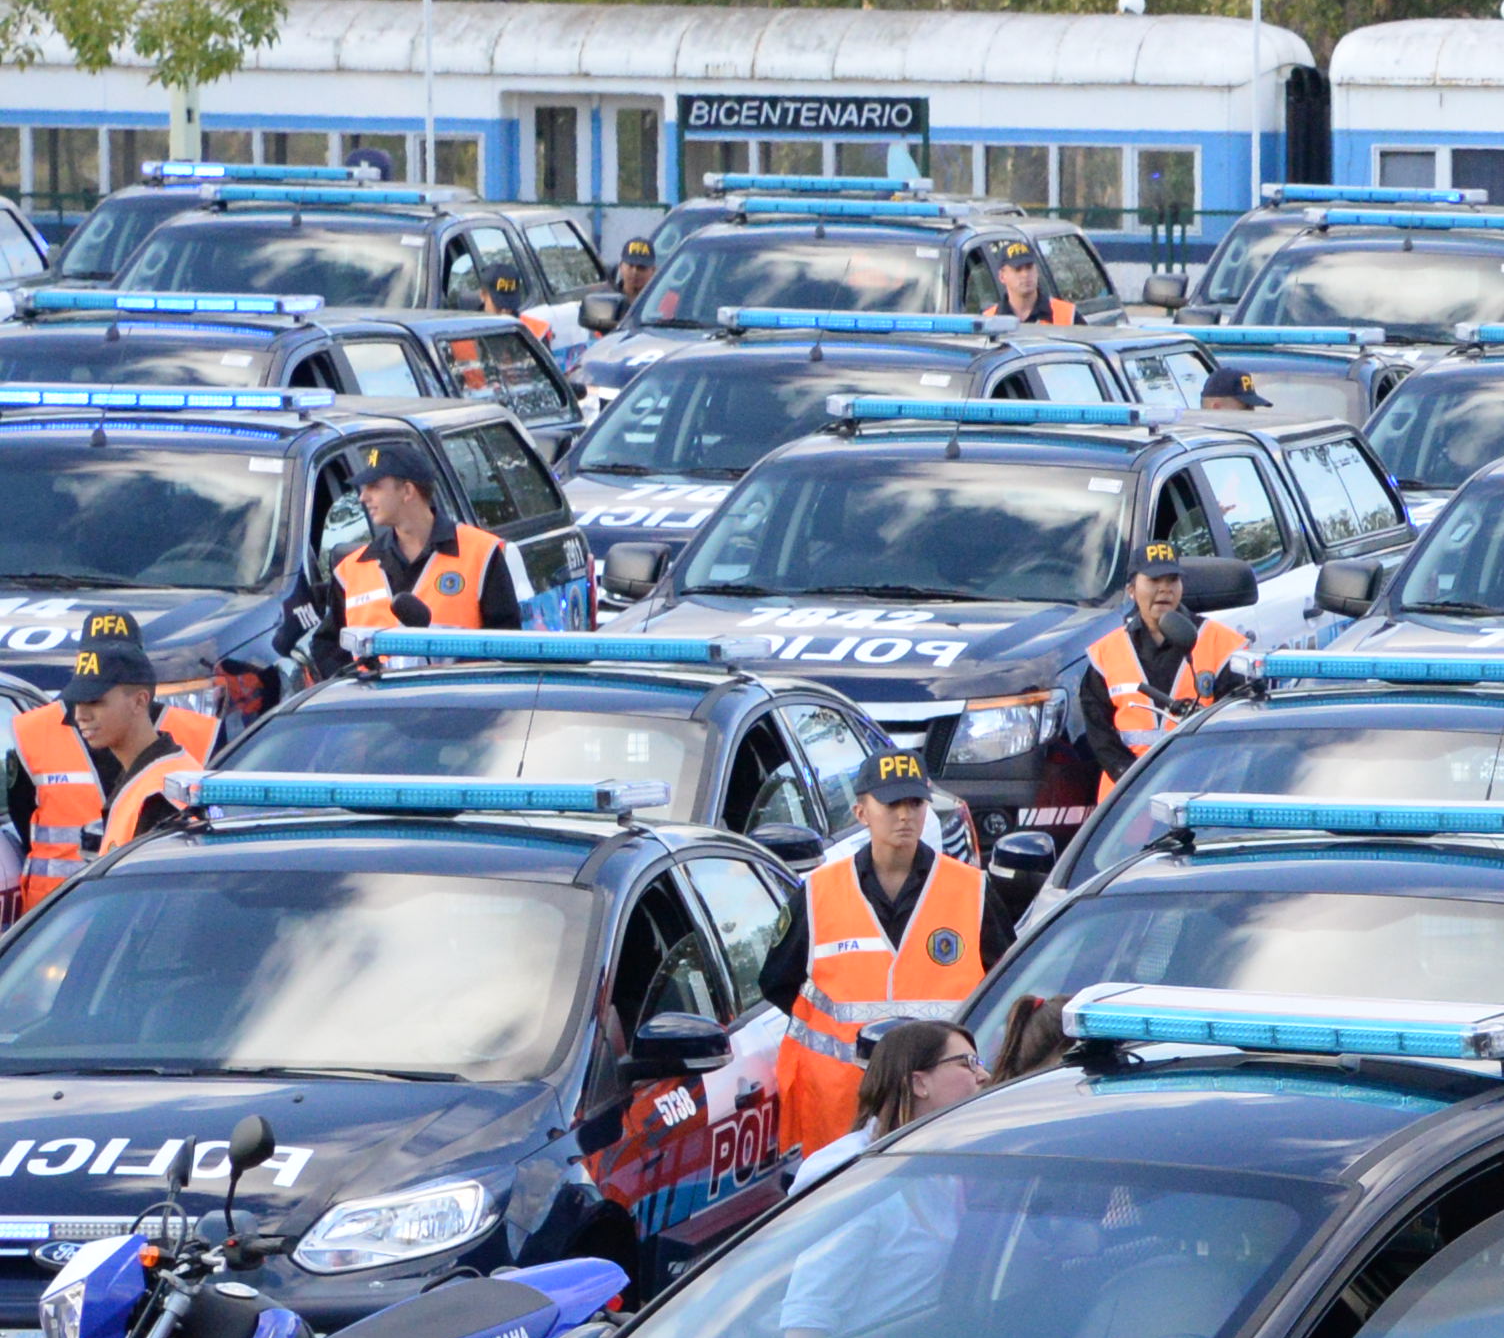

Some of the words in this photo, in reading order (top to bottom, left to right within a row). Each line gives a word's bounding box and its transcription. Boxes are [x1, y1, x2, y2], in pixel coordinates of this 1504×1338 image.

[689, 101, 912, 128] BICENTENARIO
[1147, 544, 1175, 562] PFA
[91, 615, 128, 637] PFA
[737, 608, 935, 631] 7842
[76, 653, 100, 675] FA
[879, 755, 919, 780] PFA
[48, 775, 69, 785] PFA
[838, 940, 860, 953] PFA
[653, 1085, 697, 1126] 5738
